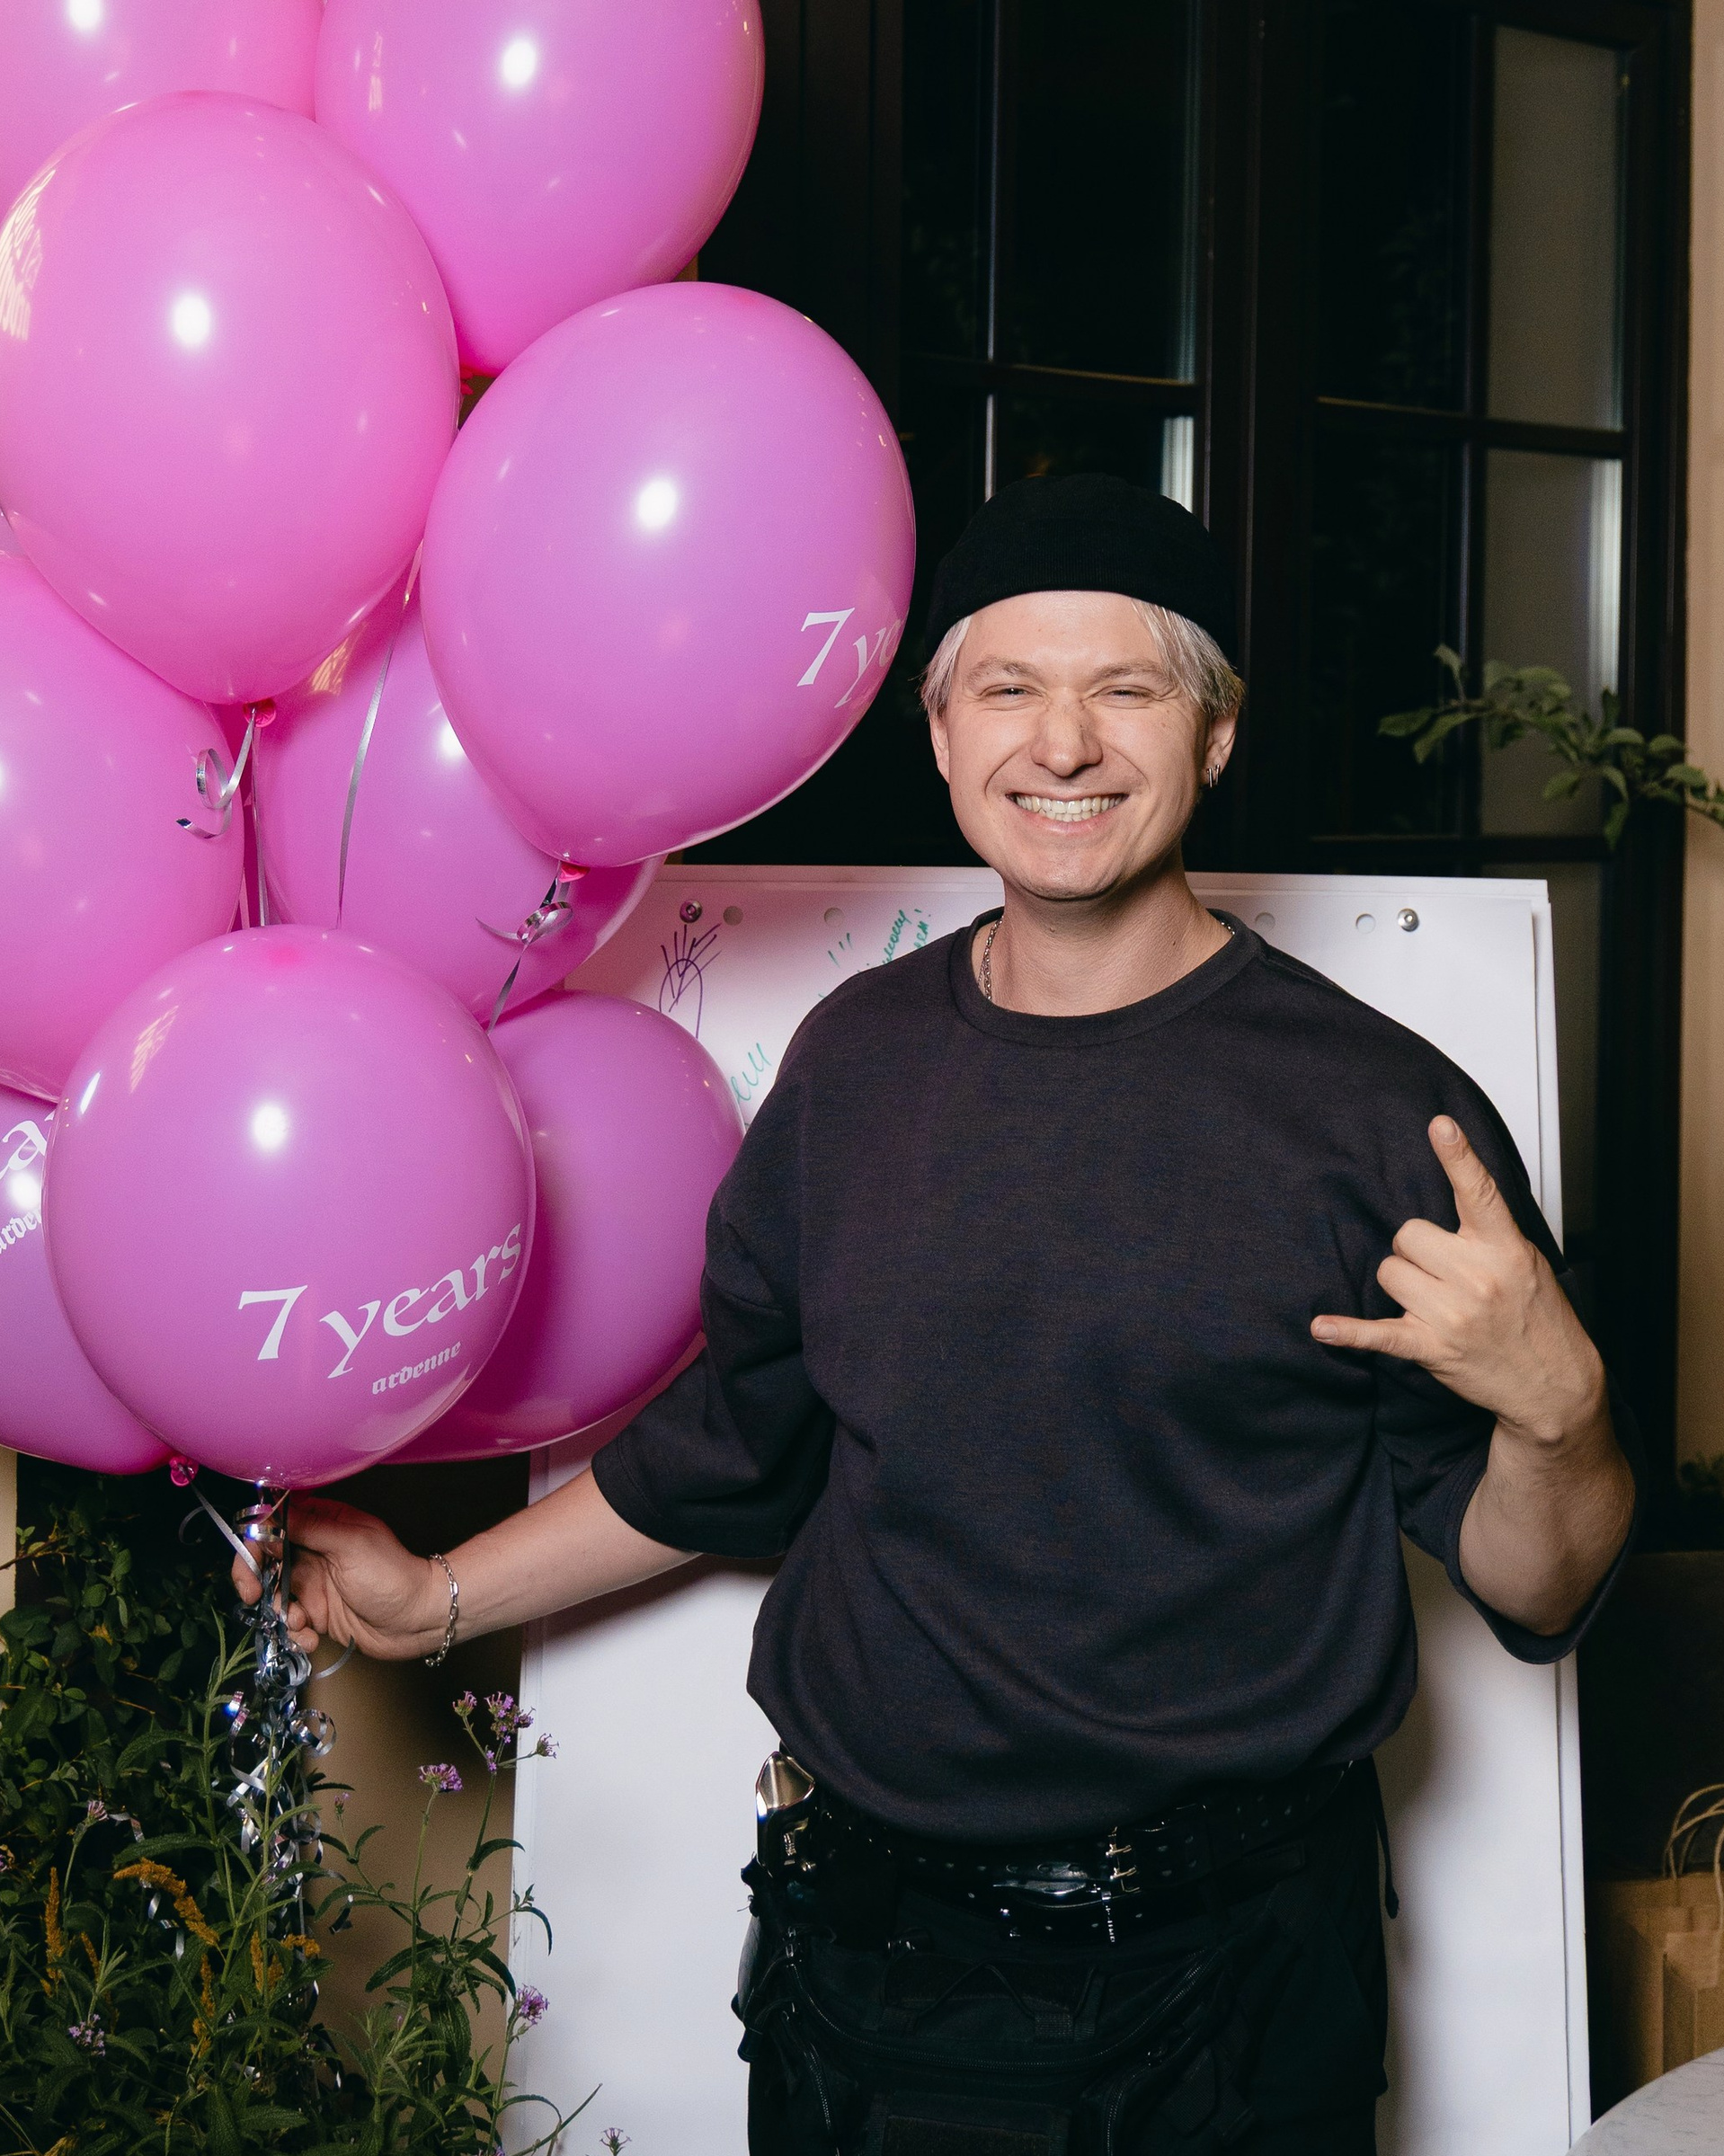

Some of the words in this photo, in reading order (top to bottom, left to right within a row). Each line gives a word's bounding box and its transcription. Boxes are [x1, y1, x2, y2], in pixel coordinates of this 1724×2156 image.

[796, 607, 856, 688] 7
[237, 1284, 308, 1361] 7
[318, 1222, 521, 1380] years
[371, 1340, 462, 1396] ardenne
